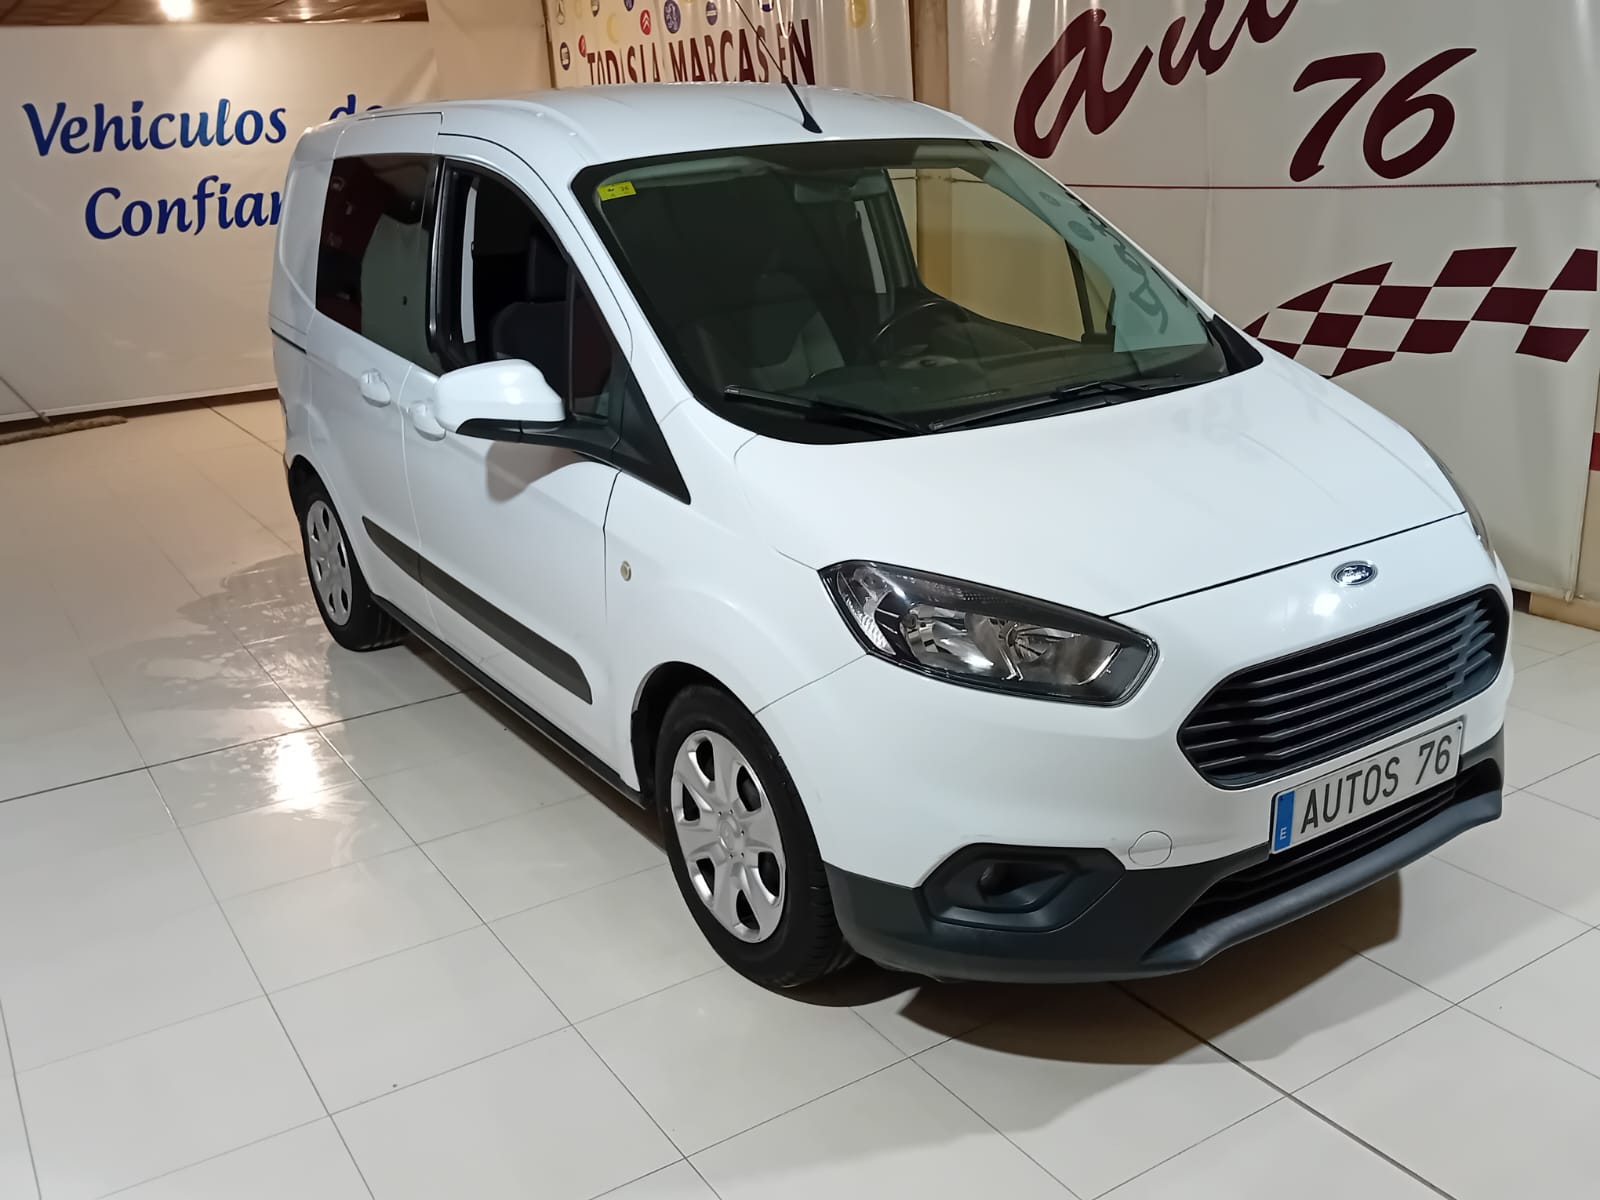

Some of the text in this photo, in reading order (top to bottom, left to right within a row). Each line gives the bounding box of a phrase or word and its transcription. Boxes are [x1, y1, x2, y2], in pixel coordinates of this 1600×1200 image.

[668, 25, 769, 82] MARCAS
[776, 18, 816, 85] EN
[22, 97, 287, 157] Vehiculos
[1289, 48, 1477, 182] 76
[1300, 735, 1452, 834] AUTOS 76
[1280, 827, 1287, 840] E
